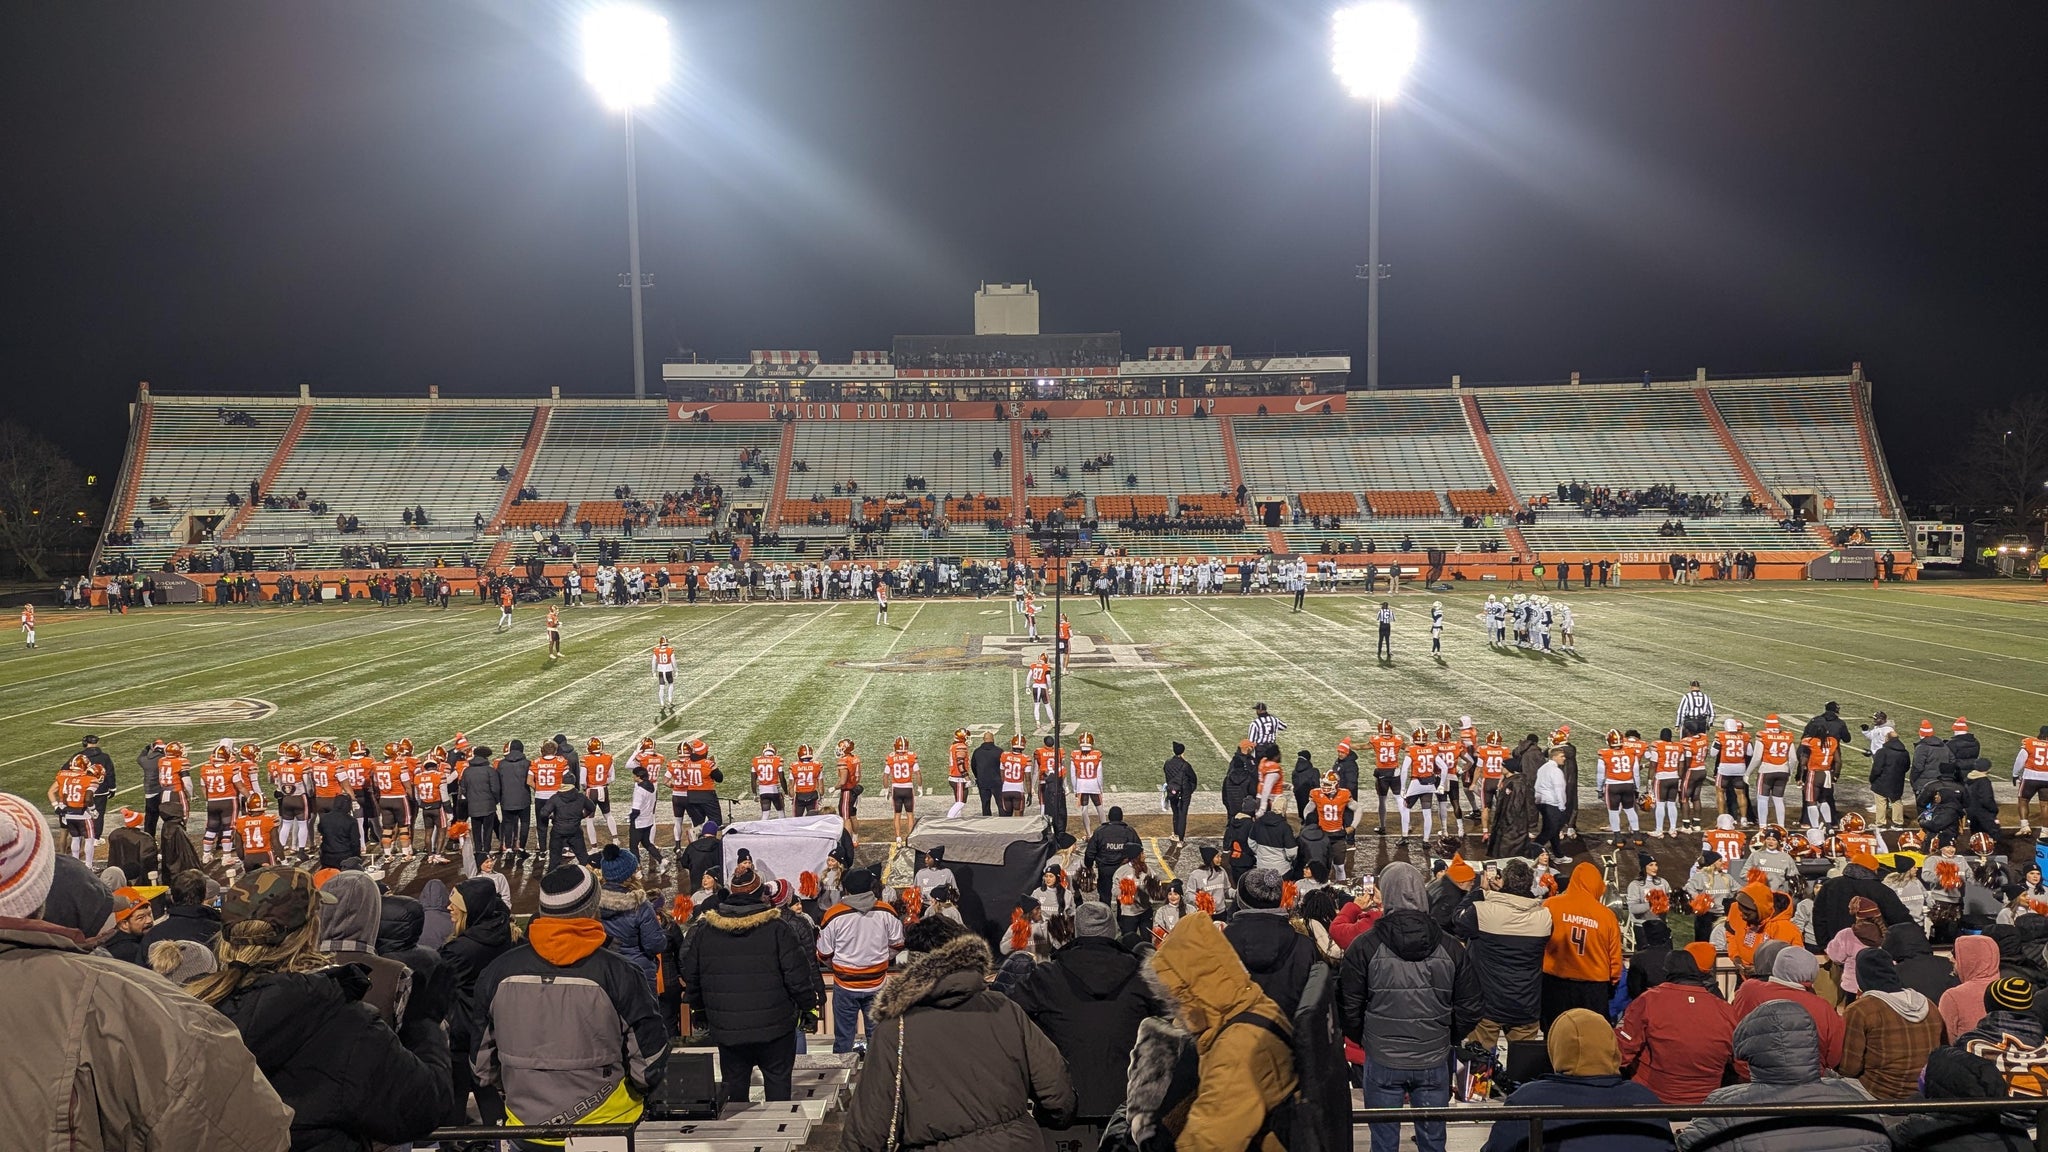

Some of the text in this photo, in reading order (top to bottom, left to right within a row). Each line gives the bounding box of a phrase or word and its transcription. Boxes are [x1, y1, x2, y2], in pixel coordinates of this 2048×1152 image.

[922, 366, 1094, 378] WELCOME TO THE DOYT
[769, 402, 953, 419] FALCON FOOTBALL
[1105, 399, 1178, 416] TALONS
[1620, 552, 1639, 563] 1959
[1379, 747, 1397, 763] 24
[1725, 739, 1745, 758] 23
[595, 763, 605, 782] 8
[757, 763, 774, 781] 30
[893, 762, 910, 779] 83
[1004, 761, 1022, 780] 20
[1079, 761, 1095, 778] 10
[1417, 755, 1434, 773] 35
[1611, 756, 1631, 773] 38
[206, 775, 226, 793] 73
[377, 771, 393, 790] 53
[538, 769, 556, 786] 66
[797, 771, 815, 786] 24
[66, 784, 82, 802] 16
[418, 782, 434, 800] 37
[244, 826, 264, 849] 14
[1716, 840, 1741, 862] 40
[1562, 912, 1599, 930] LAMPRON
[1569, 925, 1587, 956] 4
